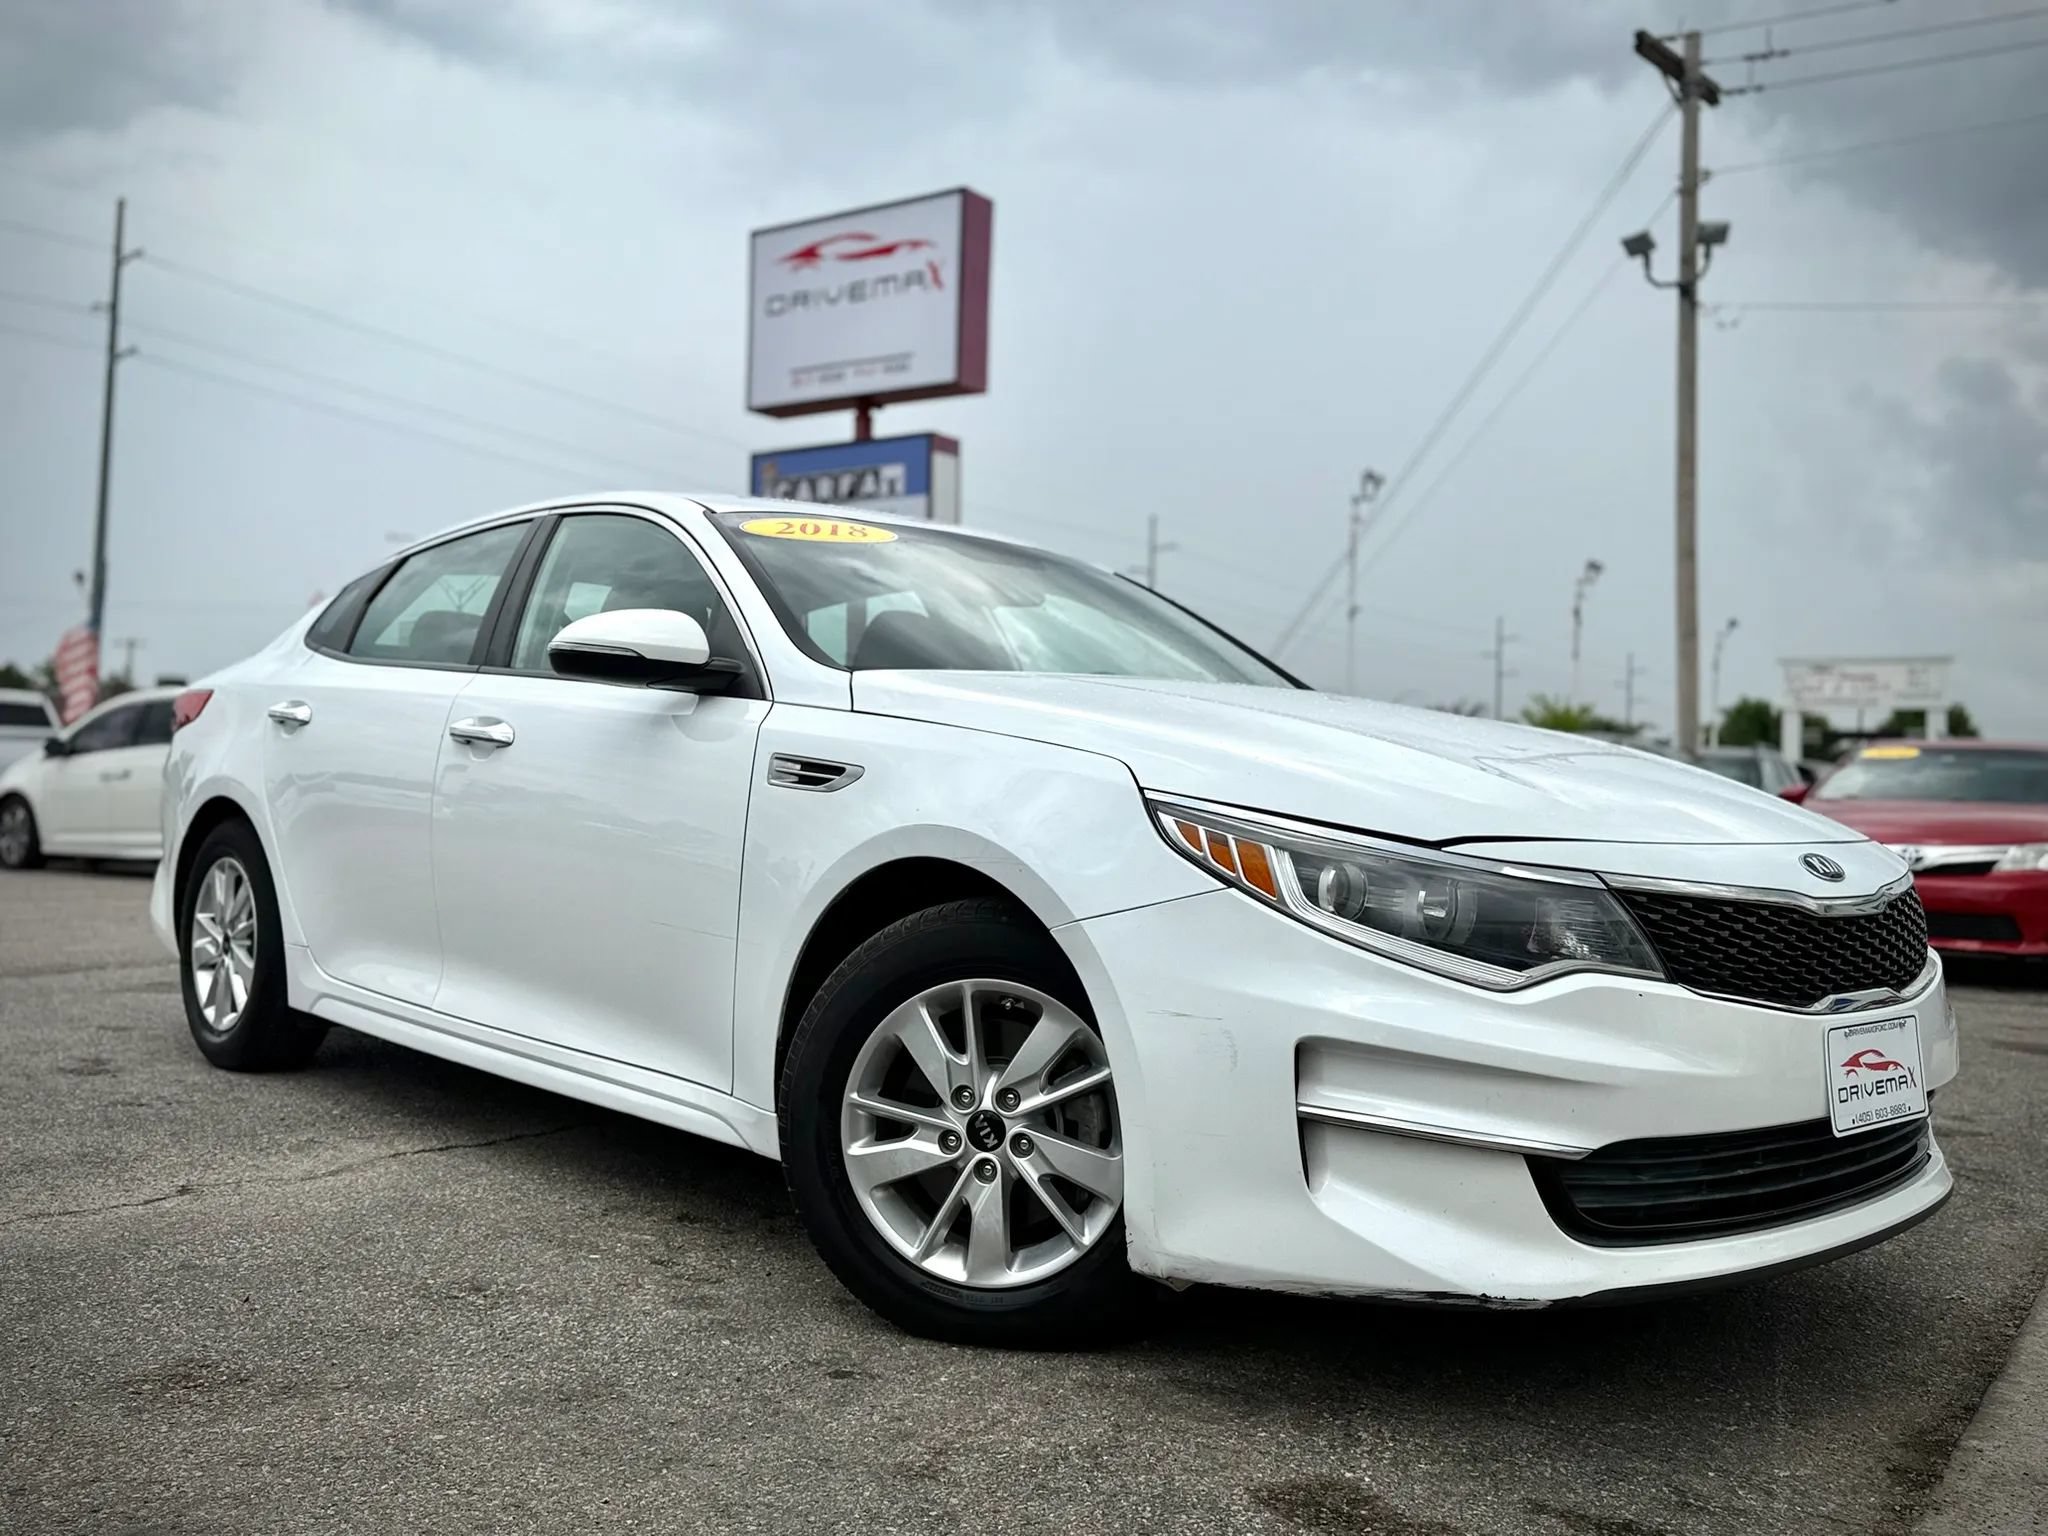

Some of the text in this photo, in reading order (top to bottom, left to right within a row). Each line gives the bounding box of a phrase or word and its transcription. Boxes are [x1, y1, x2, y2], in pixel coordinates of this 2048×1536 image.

[764, 259, 945, 317] DRIVEMAX
[776, 522, 868, 537] 2018
[1838, 1067, 1917, 1103] DRIVEMAX
[974, 1113, 999, 1148] KIA
[1855, 1111, 1874, 1124] (405)
